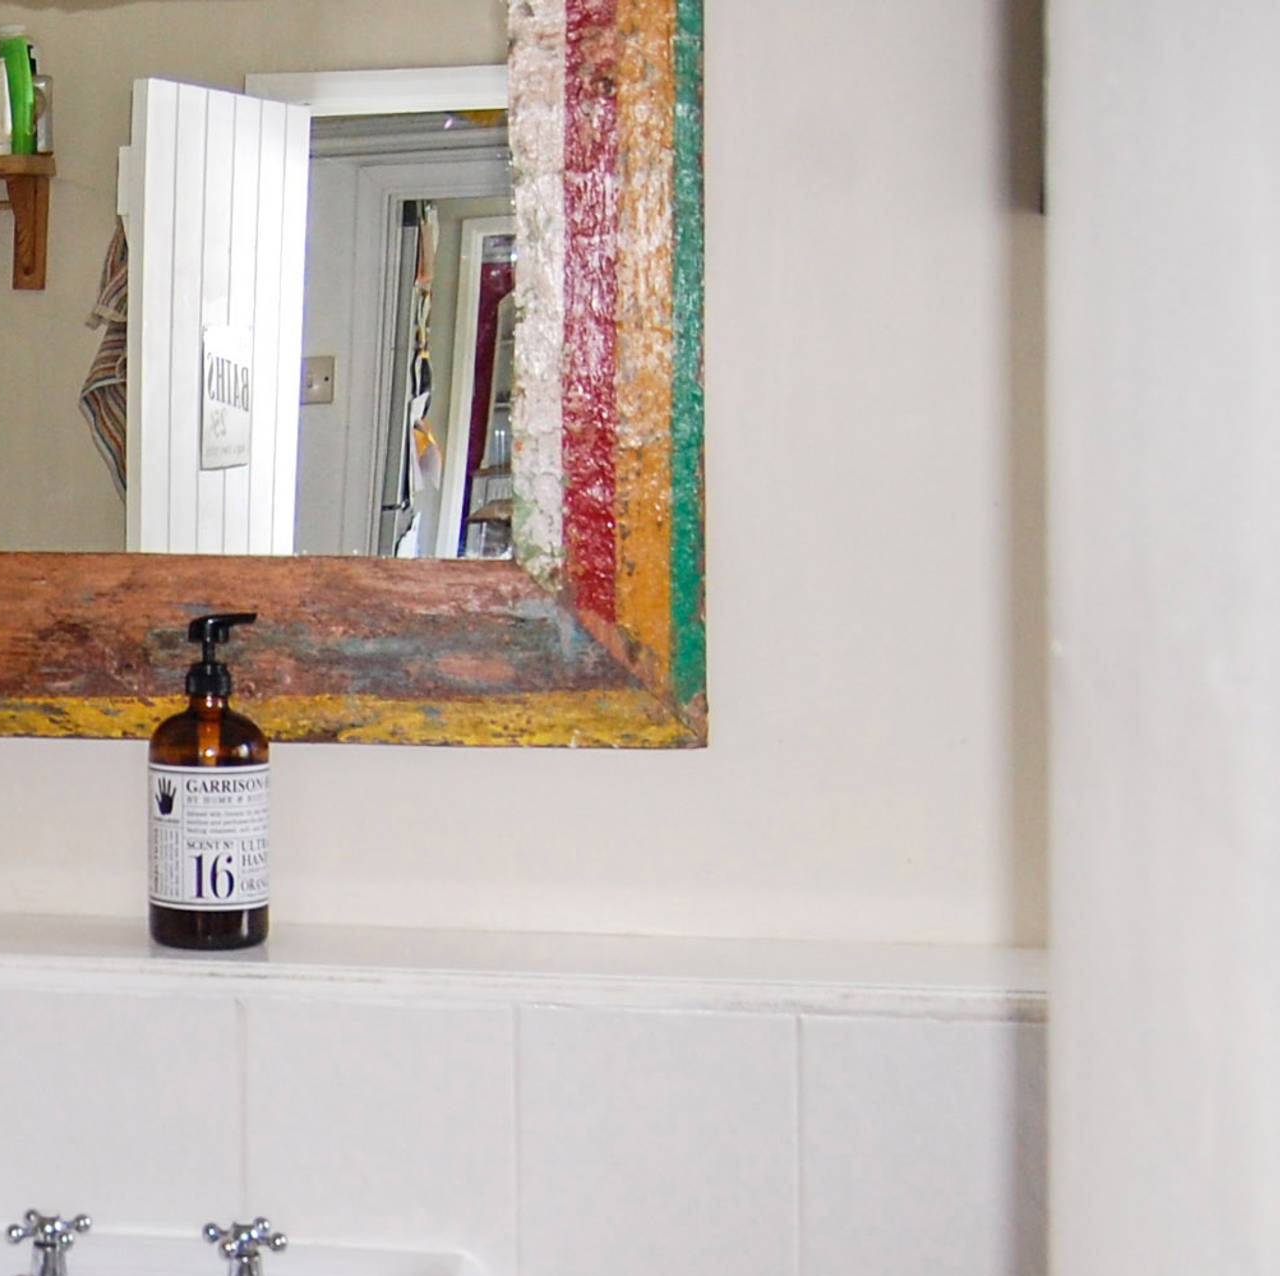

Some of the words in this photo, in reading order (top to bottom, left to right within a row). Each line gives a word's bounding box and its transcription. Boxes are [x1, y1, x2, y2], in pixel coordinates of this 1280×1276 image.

[186, 777, 264, 793] GARRISON
[242, 853, 267, 867] HAN
[188, 852, 235, 899] 16
